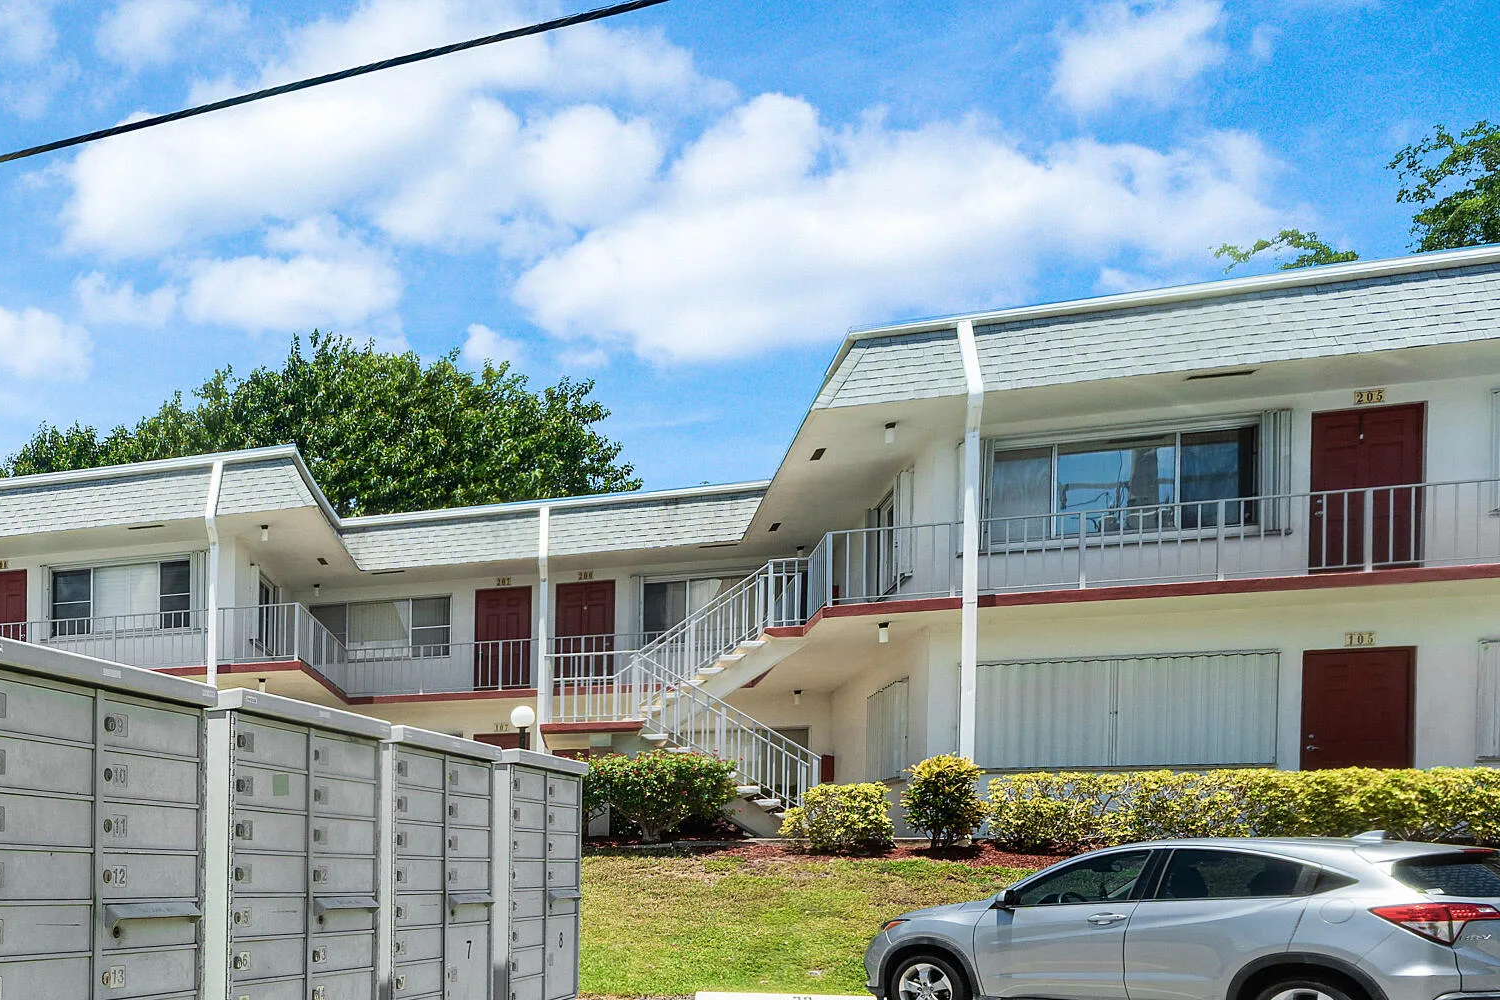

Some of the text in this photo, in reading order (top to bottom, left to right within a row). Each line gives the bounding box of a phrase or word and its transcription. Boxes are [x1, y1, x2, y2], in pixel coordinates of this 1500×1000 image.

[1356, 391, 1384, 404] 205
[1348, 633, 1375, 646] 105
[114, 818, 126, 834] 11
[113, 868, 126, 885] 12
[243, 911, 249, 924] 5
[558, 932, 565, 948] 8
[466, 940, 473, 959] 7
[242, 953, 248, 967] 6
[112, 969, 124, 984] 13
